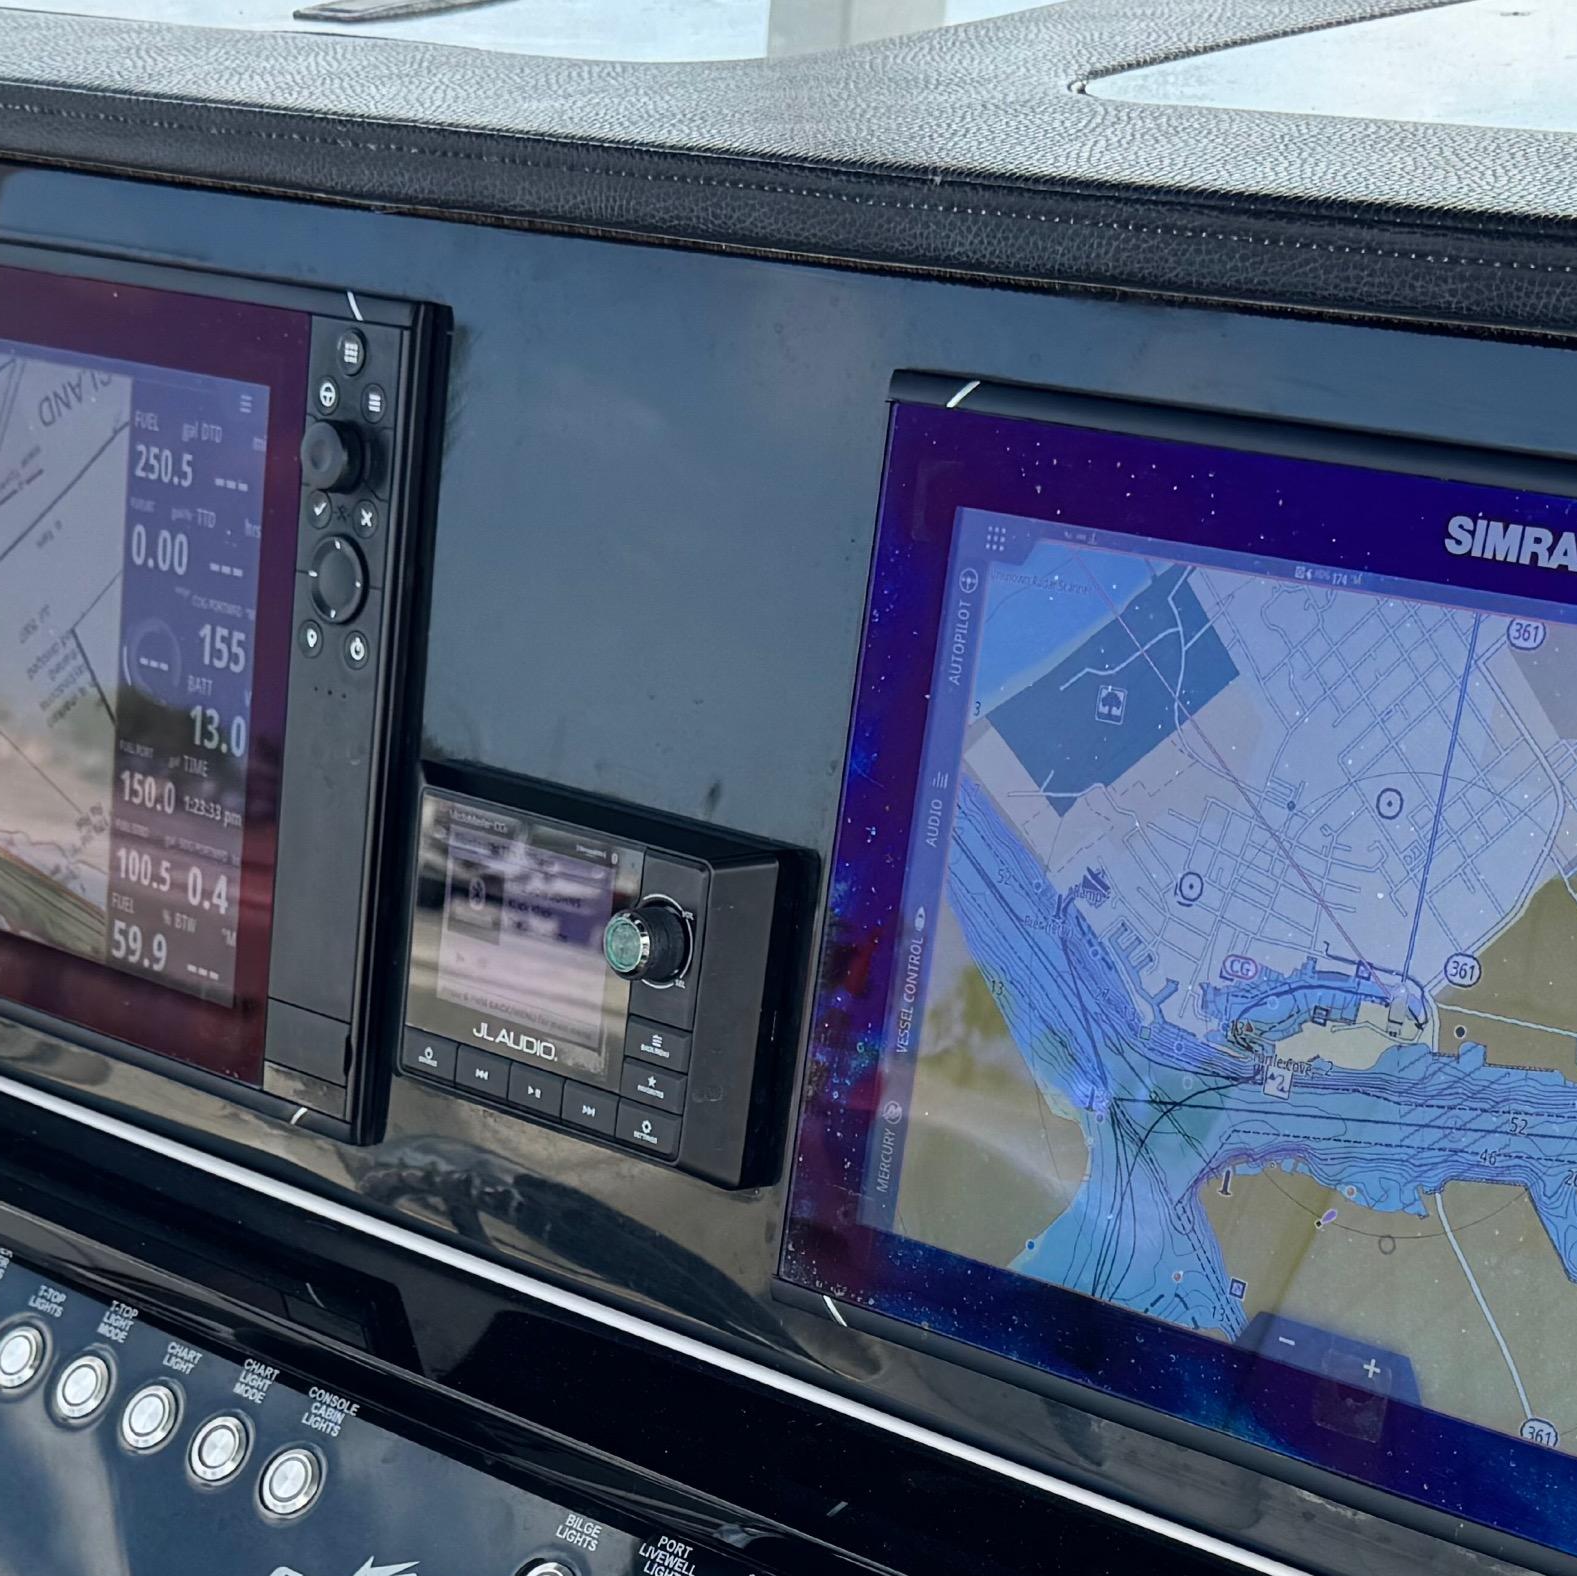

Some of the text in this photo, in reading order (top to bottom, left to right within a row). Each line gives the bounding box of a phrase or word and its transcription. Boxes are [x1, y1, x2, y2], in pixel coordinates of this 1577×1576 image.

[135, 411, 159, 431] FUEL
[201, 423, 222, 443] DTD
[135, 444, 193, 487] 250.5
[132, 524, 188, 575] 0.00
[948, 600, 972, 686] AUTOPILOT
[1513, 623, 1540, 644] 361
[199, 624, 246, 673] 155
[188, 675, 213, 696] BATT
[190, 705, 246, 757] 13.0
[184, 755, 209, 778] TIME
[121, 770, 175, 815] 150.0
[184, 796, 242, 827] 1:23:33 pm
[925, 799, 942, 848] AUDIO
[117, 847, 171, 892] 100.5
[188, 866, 228, 914] 0.4
[111, 892, 135, 914] FUEL
[175, 911, 197, 933] BTW
[111, 919, 167, 972] 59.9
[1229, 959, 1252, 976] CG
[1449, 960, 1476, 981] 361
[896, 937, 924, 1054] VESSEL CONTROL
[1509, 1117, 1528, 1135] 52
[876, 1128, 896, 1193] MERCURY
[1479, 1149, 1498, 1165] 46
[37, 1285, 67, 1303] T-TOP
[28, 1296, 64, 1318] LIGHTS
[110, 1300, 139, 1319] T-TOP
[103, 1312, 134, 1331] LIGHT
[96, 1323, 128, 1344] MODE
[167, 1341, 203, 1364] CHART
[163, 1354, 195, 1375] LIGHT
[244, 1358, 280, 1380] CHART
[239, 1371, 272, 1391] LIGHT
[233, 1383, 266, 1404] MODE
[308, 1386, 361, 1417] CONSOLE
[301, 1412, 341, 1437] LIGHTS
[310, 1402, 345, 1425] CABIN
[1526, 1426, 1553, 1445] 361
[565, 1514, 602, 1539] BILGE
[556, 1525, 599, 1553] LIGHTS
[657, 1536, 692, 1557] PORT
